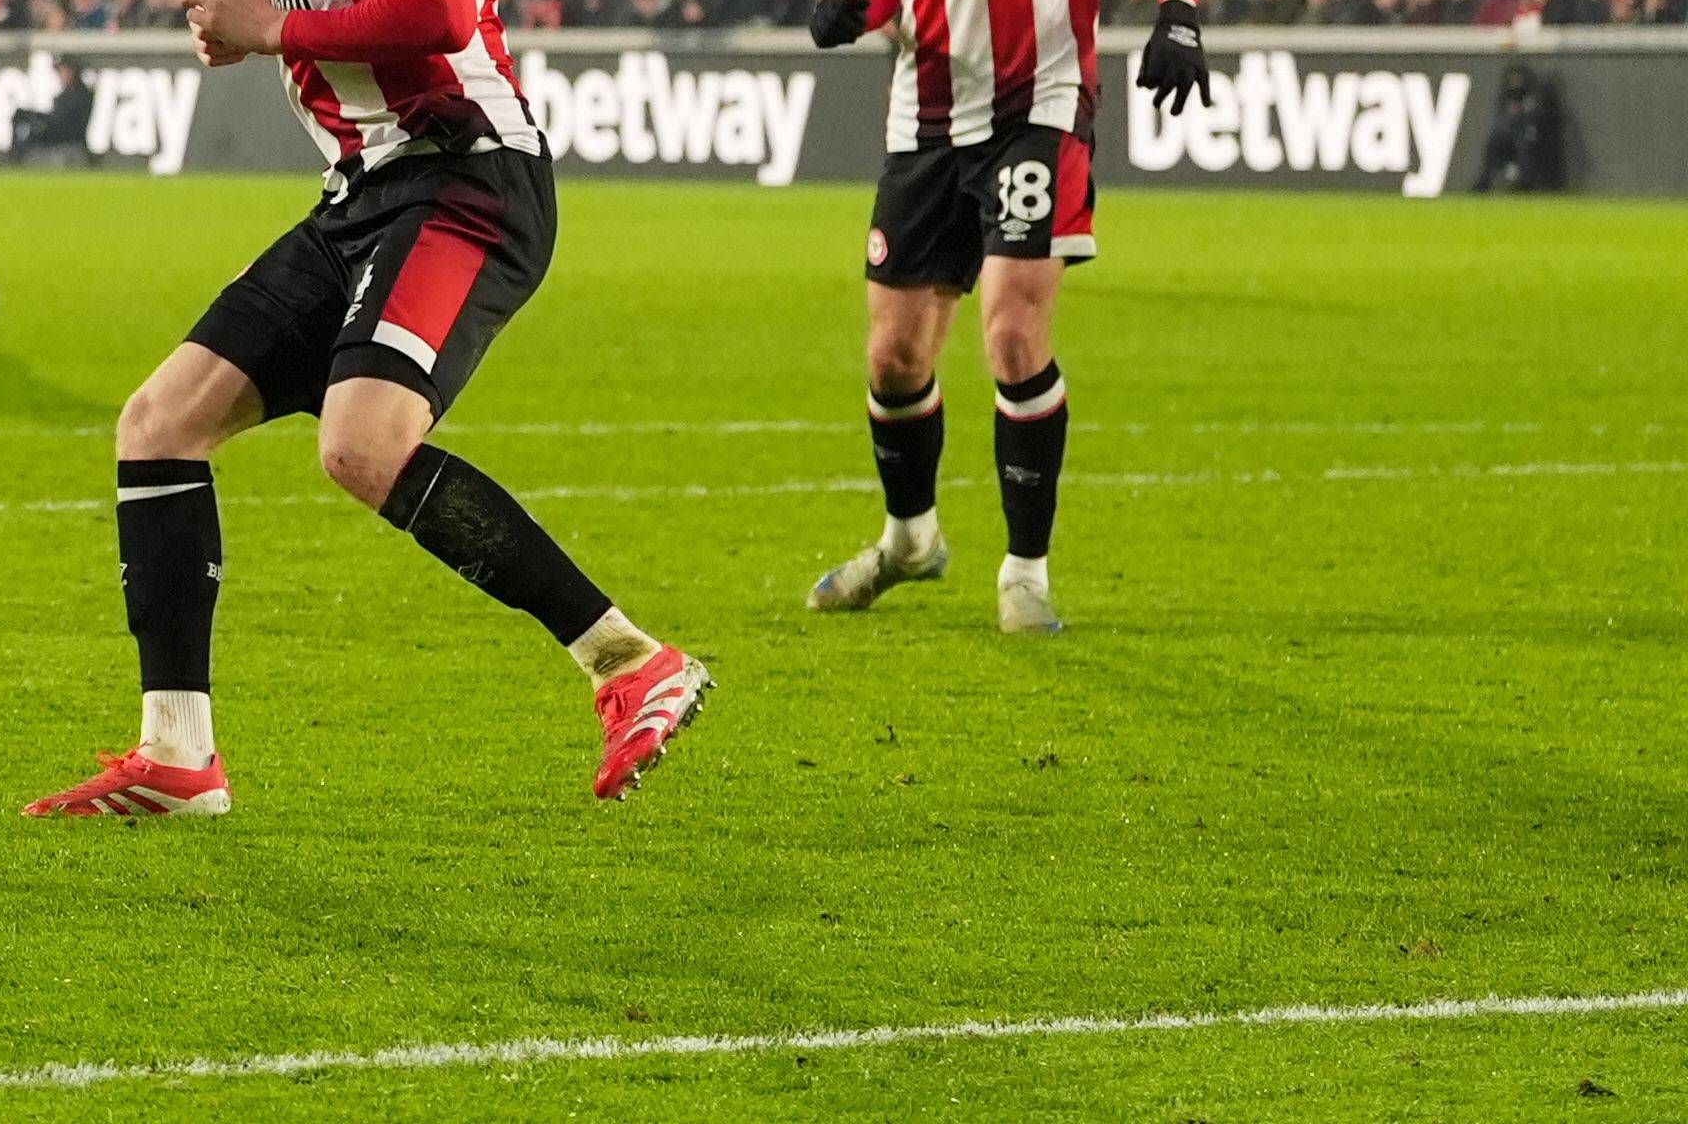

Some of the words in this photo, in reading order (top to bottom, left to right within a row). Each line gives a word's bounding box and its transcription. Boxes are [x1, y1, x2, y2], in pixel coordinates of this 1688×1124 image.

[520, 50, 816, 187] betway
[1127, 50, 1471, 198] betway
[998, 160, 1052, 221] 18
